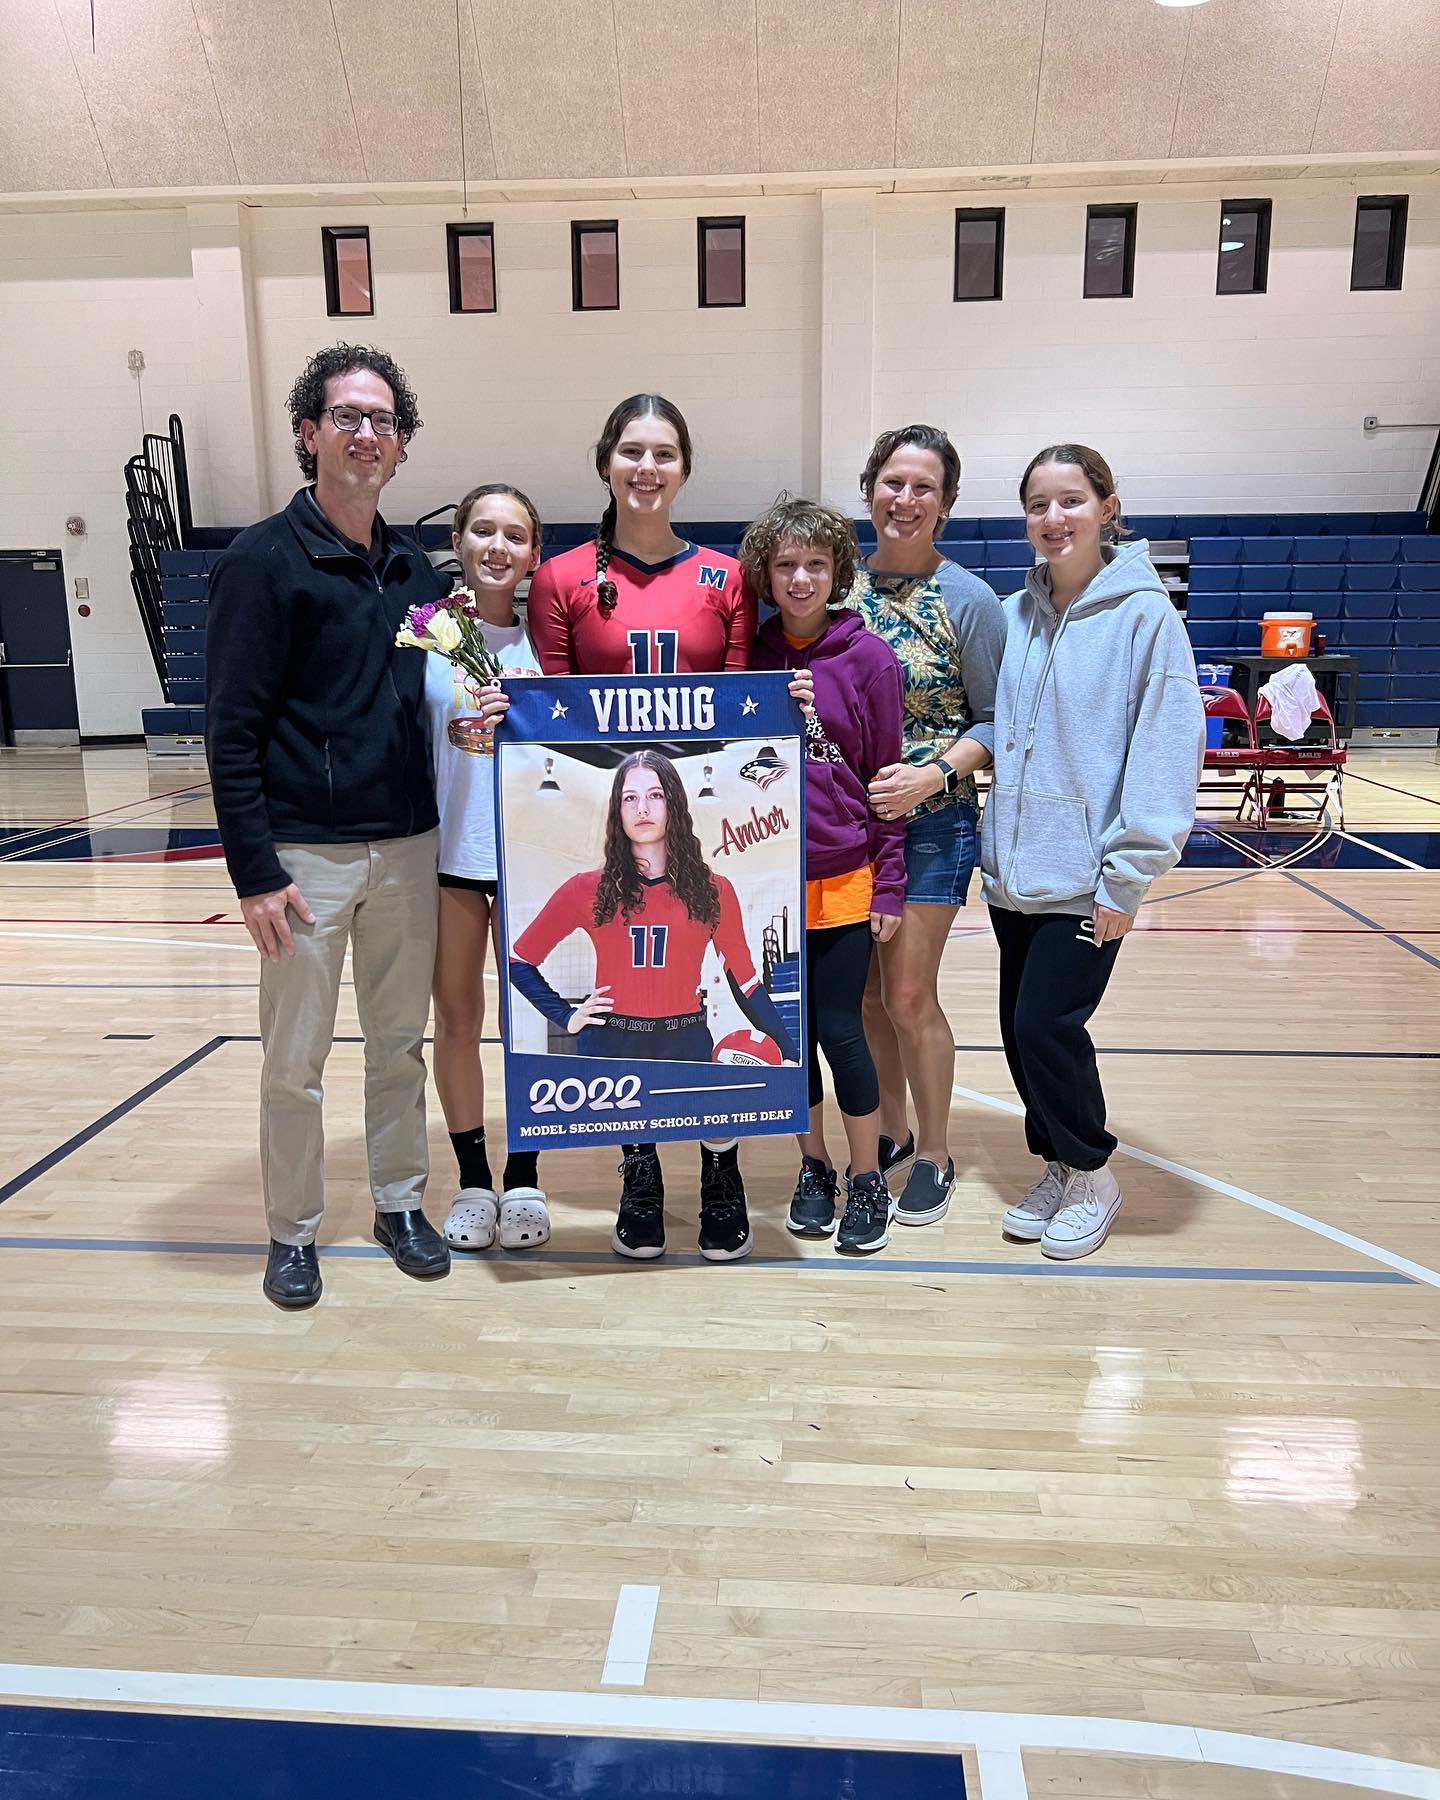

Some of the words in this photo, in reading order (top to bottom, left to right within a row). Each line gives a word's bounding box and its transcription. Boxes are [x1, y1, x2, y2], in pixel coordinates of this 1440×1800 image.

[697, 565, 728, 590] M
[627, 630, 679, 674] 11
[589, 686, 716, 733] VIRNIG
[712, 805, 789, 859] Amber
[629, 925, 669, 969] 11
[529, 1074, 642, 1114] 2022
[520, 1123, 567, 1137] MODEL
[569, 1119, 648, 1134] SECONDARY
[649, 1115, 701, 1129] SCHOOL
[703, 1113, 729, 1125] FOR
[731, 1111, 758, 1123] THE
[759, 1109, 793, 1121] DEAF
